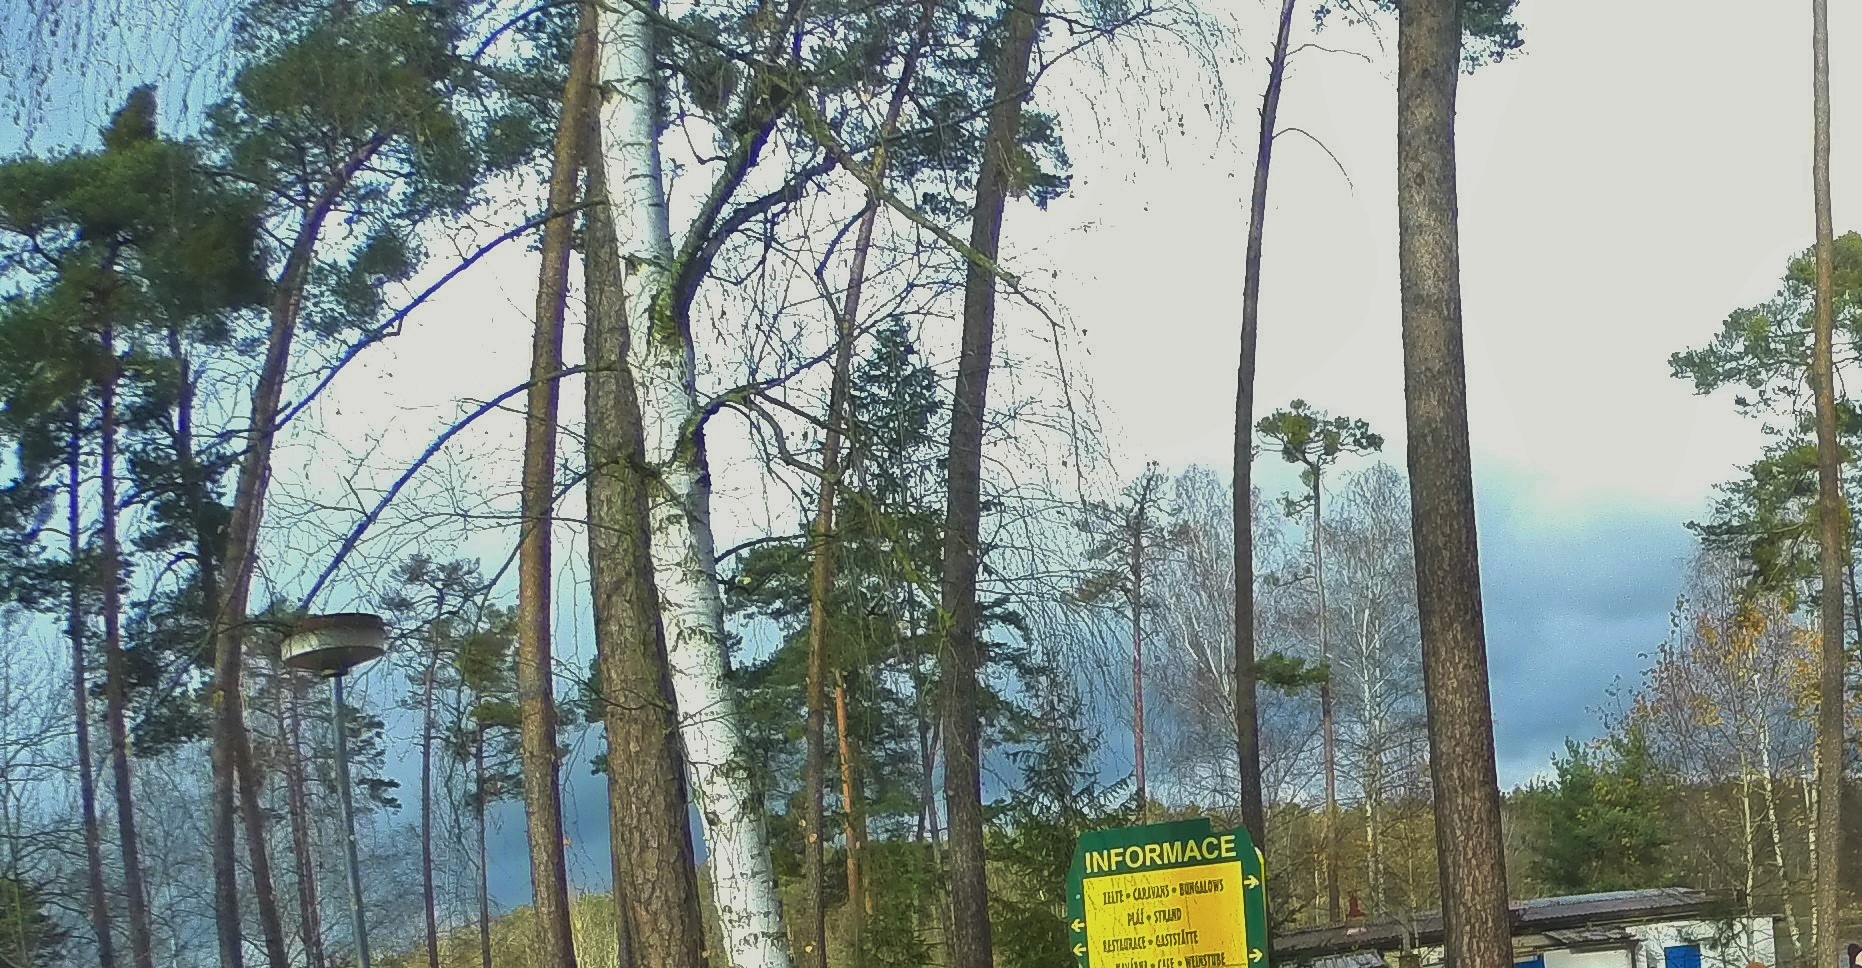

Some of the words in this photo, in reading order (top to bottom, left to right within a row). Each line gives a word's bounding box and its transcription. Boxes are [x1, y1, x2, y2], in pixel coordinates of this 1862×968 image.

[1085, 835, 1237, 874] INFORMACE
[1133, 885, 1169, 901] CARAVANS
[1179, 879, 1224, 896] BUNGALOWS
[1154, 908, 1182, 923] STRAND
[1103, 936, 1146, 952] RESTAURACE
